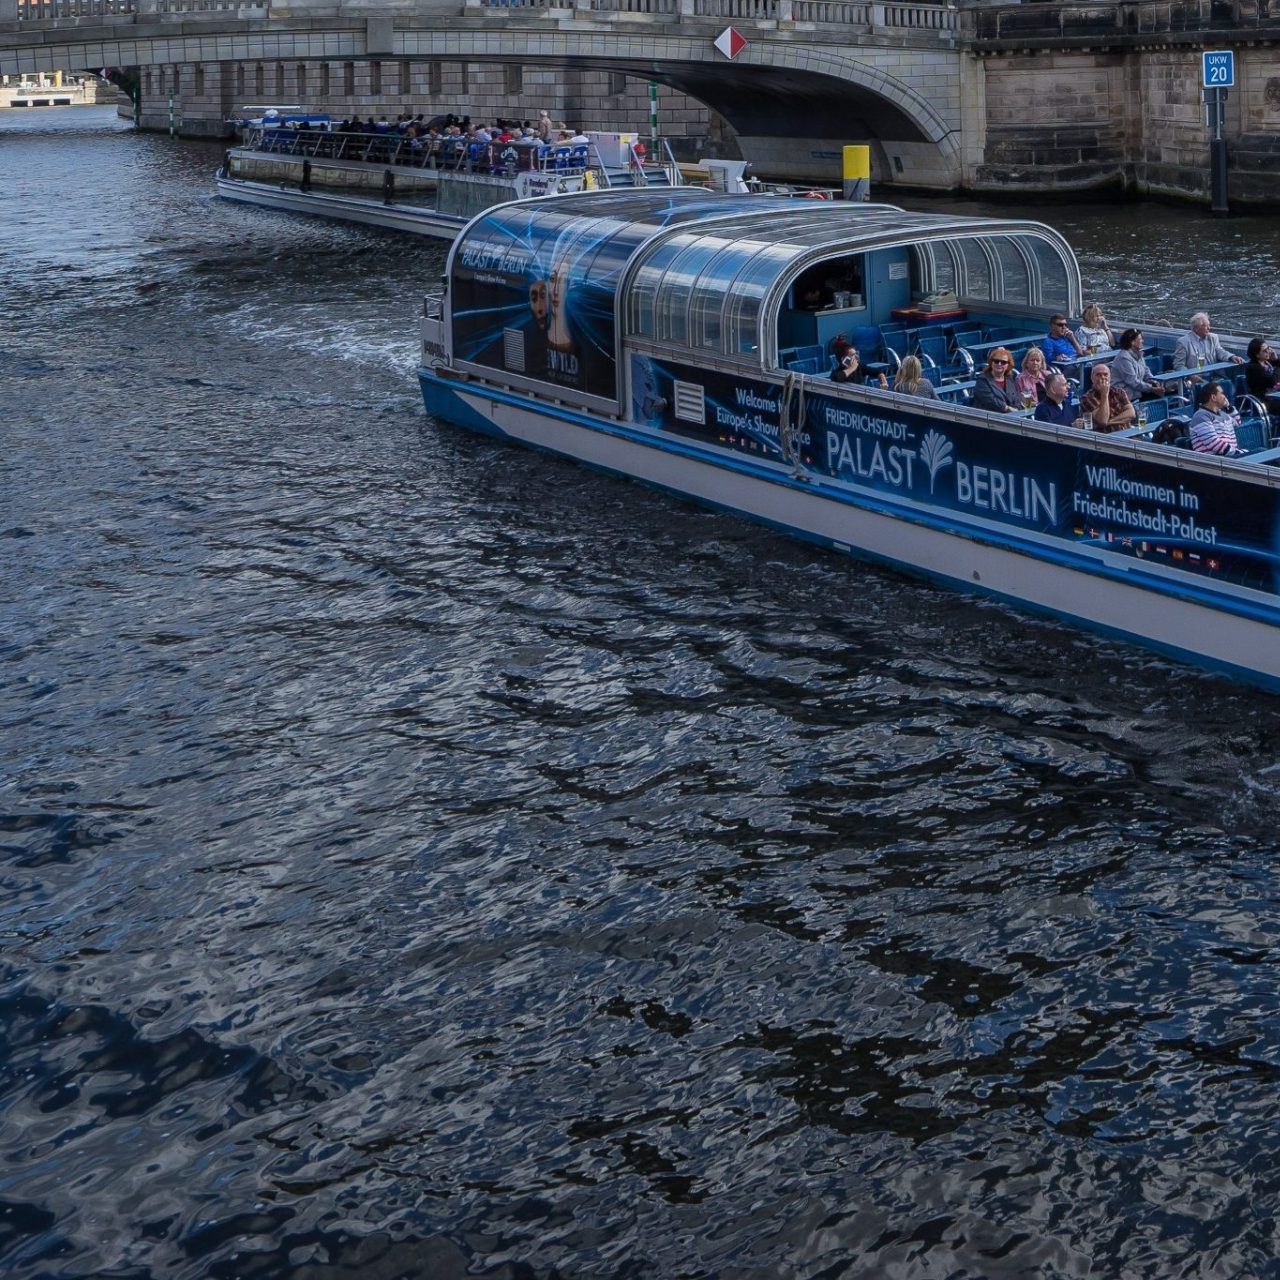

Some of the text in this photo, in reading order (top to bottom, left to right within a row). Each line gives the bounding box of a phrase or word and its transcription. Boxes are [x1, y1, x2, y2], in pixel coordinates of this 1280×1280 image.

[1208, 56, 1228, 65] UKW
[1210, 66, 1227, 82] 20
[735, 387, 776, 413] Welcome
[716, 406, 753, 432] Europe's
[754, 416, 779, 436] Show
[825, 407, 916, 441] FRIEDRICHSTADT-
[826, 430, 1058, 526] PALAST BERLIN
[1085, 464, 1199, 510] Willkommen im
[1073, 491, 1217, 545] Friedrichstadt-Palast
